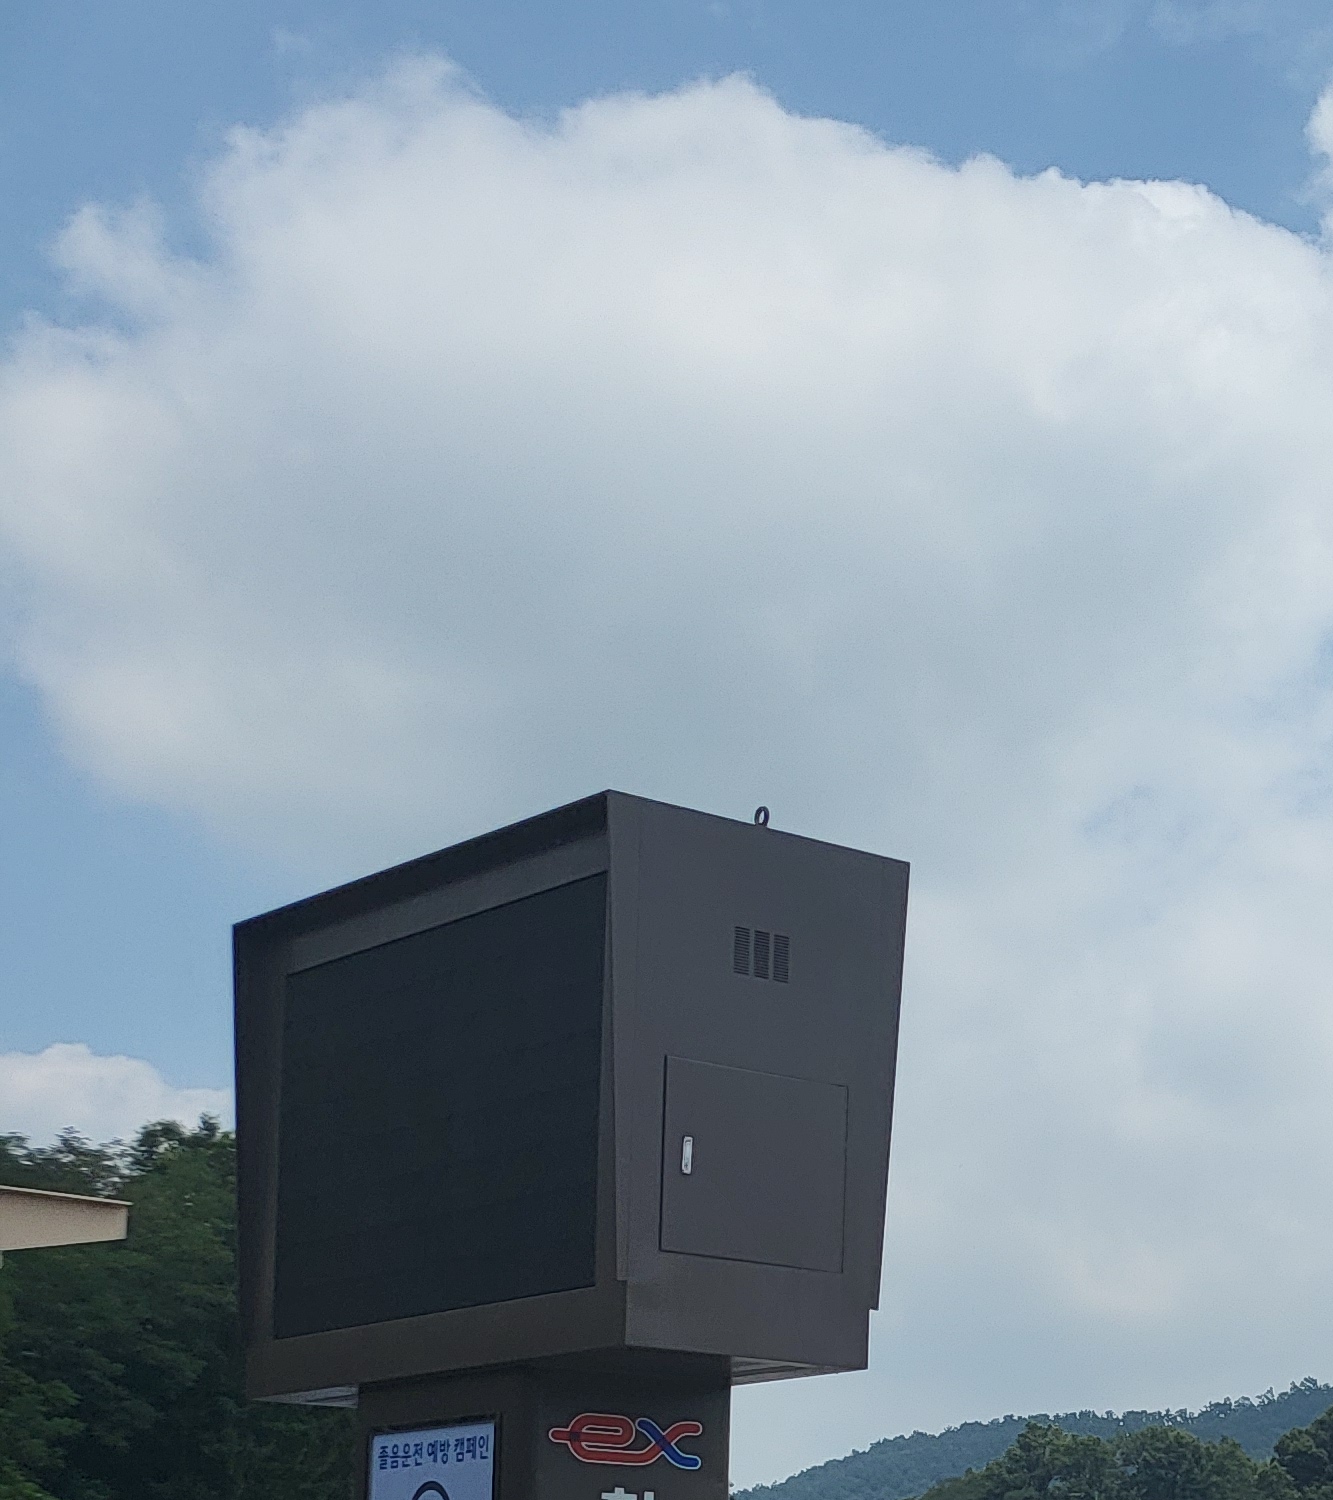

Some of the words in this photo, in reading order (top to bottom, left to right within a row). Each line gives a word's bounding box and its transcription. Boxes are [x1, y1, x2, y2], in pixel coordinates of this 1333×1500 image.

[378, 1441, 423, 1470] 졸음운전
[427, 1439, 451, 1465] 예방
[454, 1434, 489, 1462] 캠페인
[548, 1412, 703, 1470] ex
